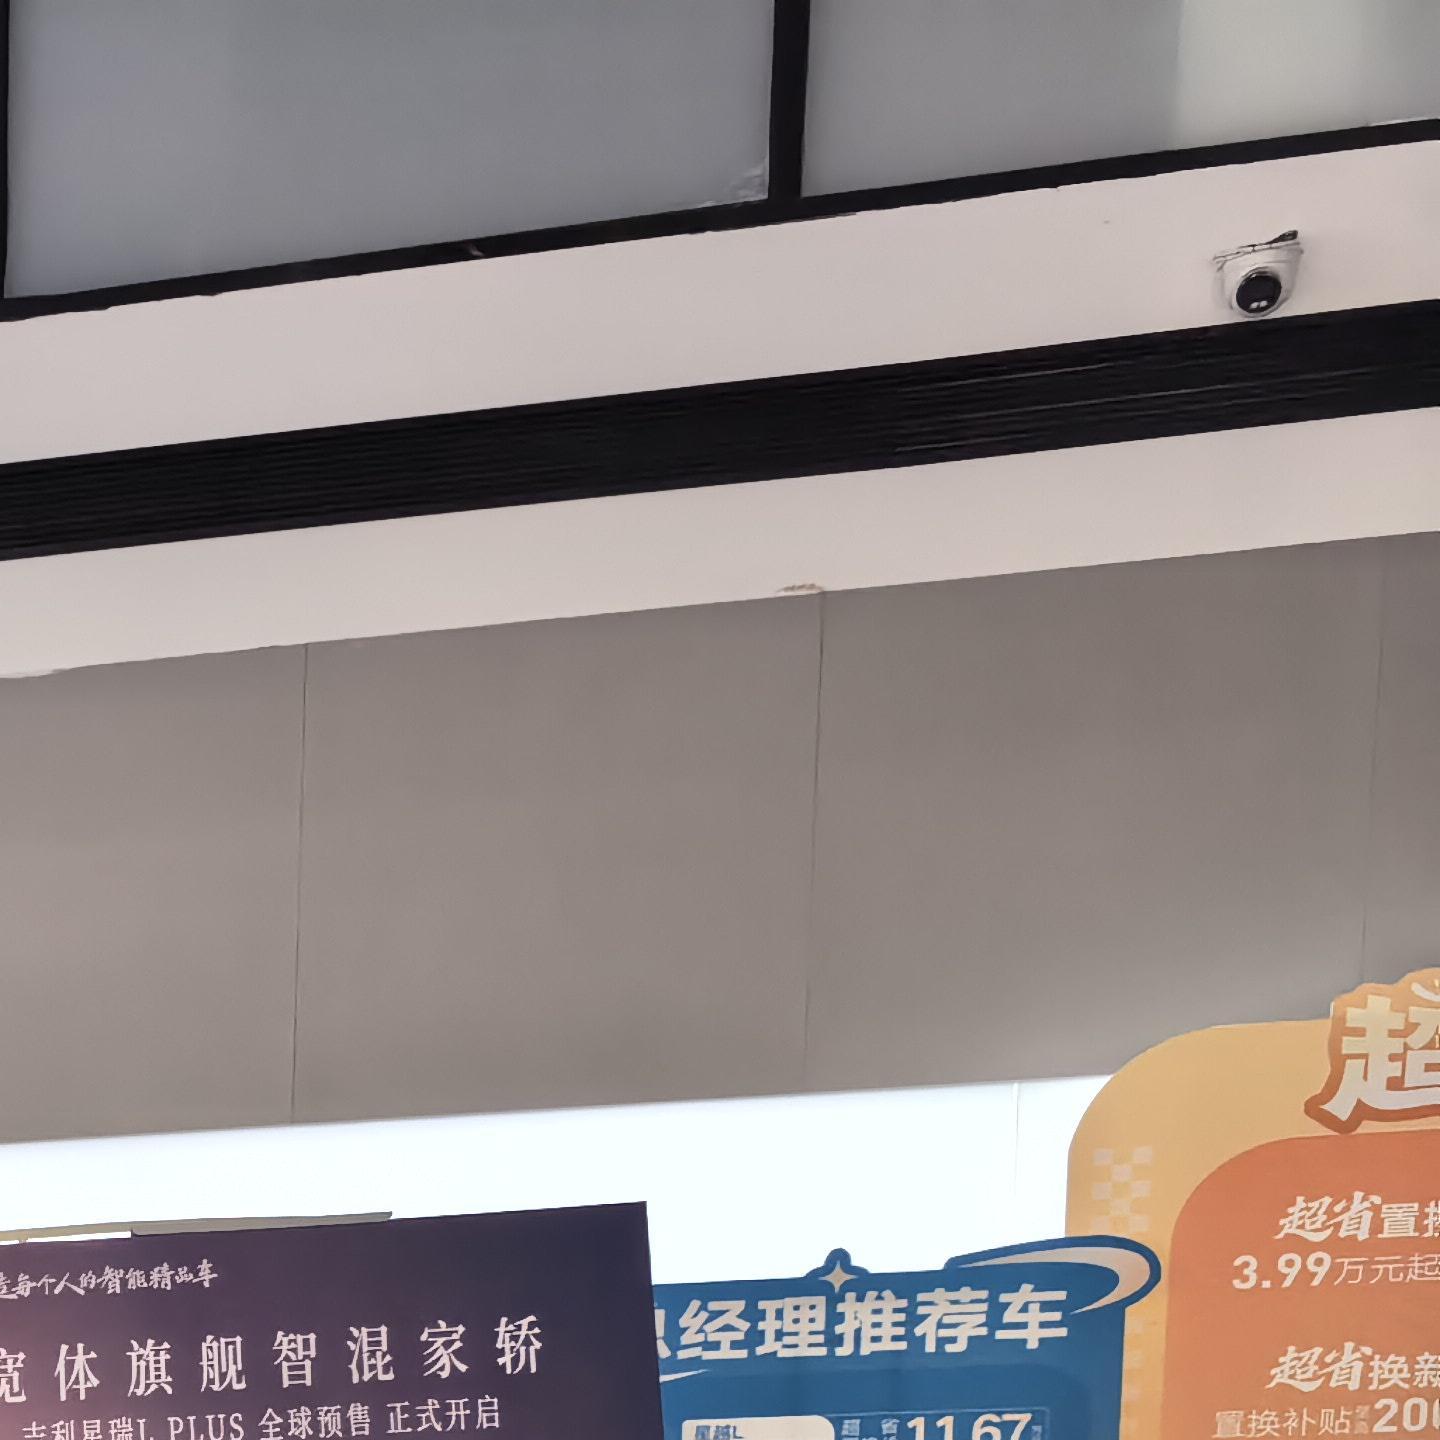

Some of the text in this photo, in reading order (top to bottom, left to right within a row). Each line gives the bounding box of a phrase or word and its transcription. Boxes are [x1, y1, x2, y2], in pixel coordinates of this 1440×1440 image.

[655, 1283, 1069, 1361] 经理推荐车
[386, 1395, 501, 1436] 正式开启
